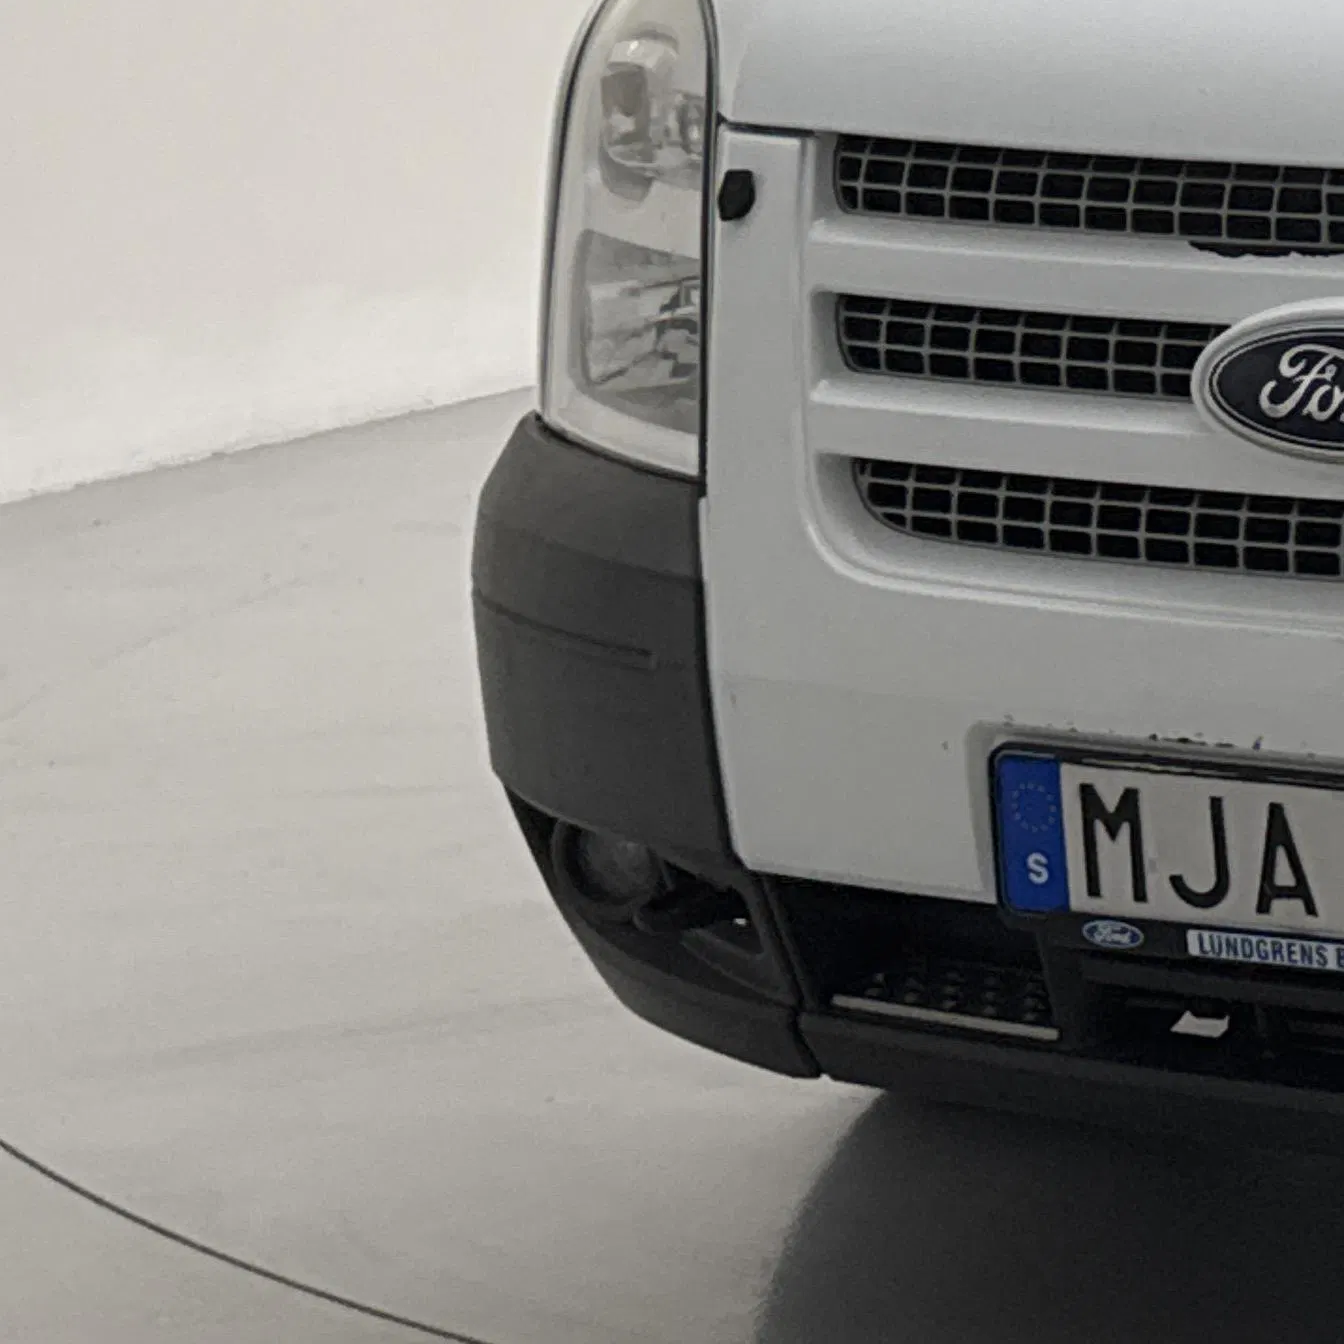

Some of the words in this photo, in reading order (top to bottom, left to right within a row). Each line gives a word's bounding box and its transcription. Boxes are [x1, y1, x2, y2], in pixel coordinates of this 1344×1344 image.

[1027, 852, 1049, 885] S
[1078, 782, 1319, 918] MJA
[1197, 931, 1329, 968] LUNDGRENS
